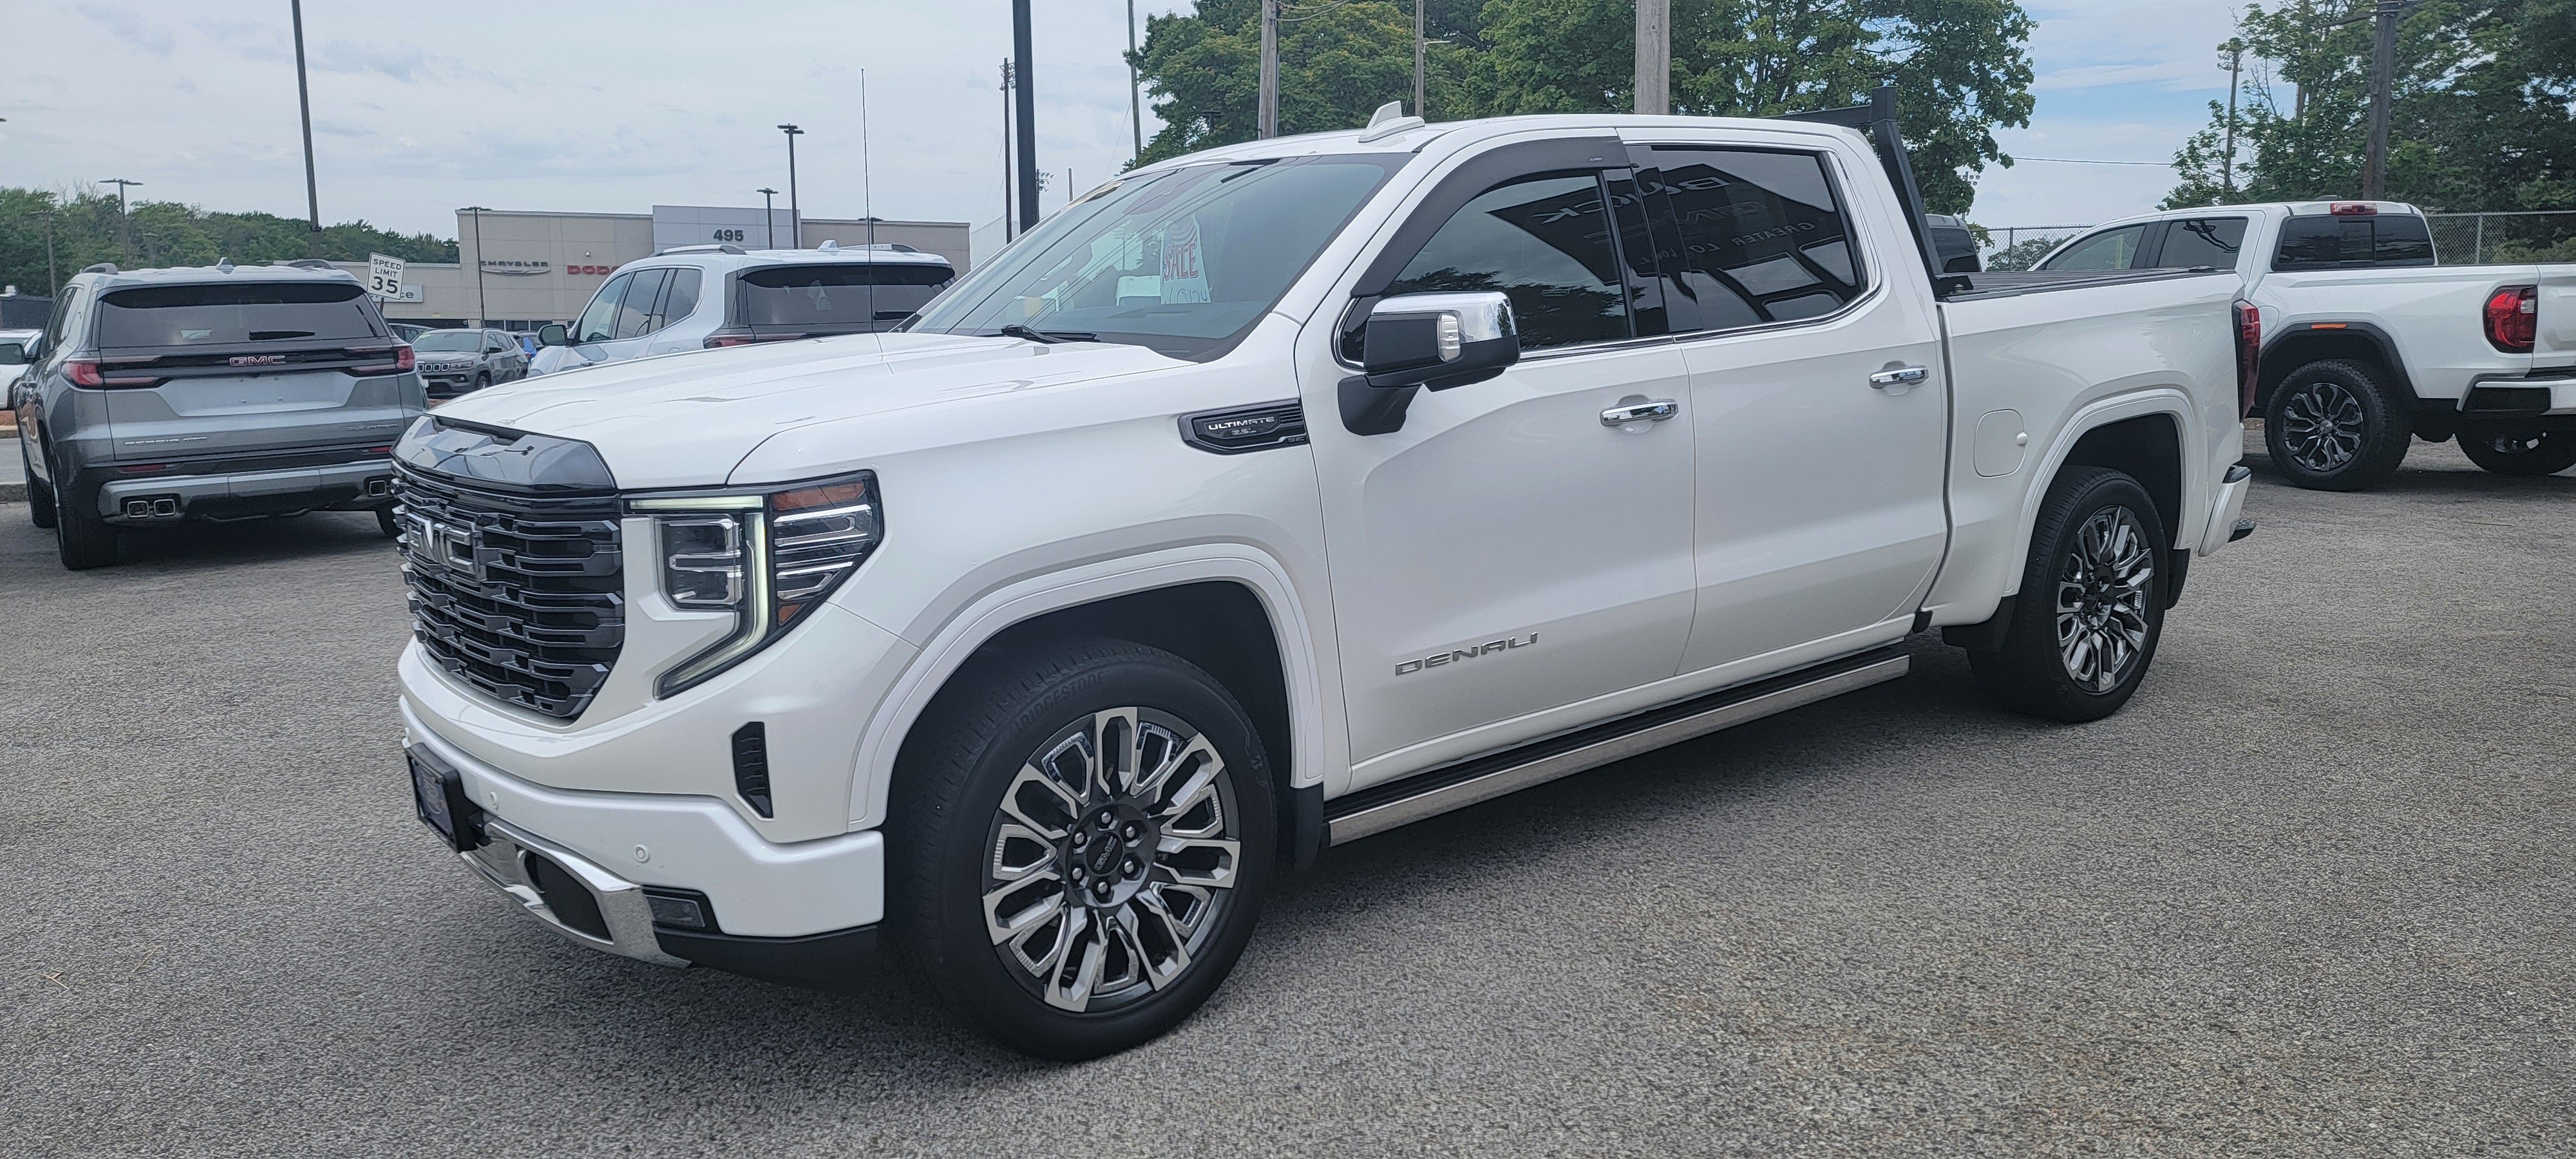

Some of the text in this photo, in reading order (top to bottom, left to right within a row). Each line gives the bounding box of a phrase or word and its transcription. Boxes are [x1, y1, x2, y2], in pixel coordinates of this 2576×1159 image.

[713, 229, 744, 242] 495
[373, 258, 401, 270] SPEED
[1163, 243, 1199, 281] SALE
[375, 267, 397, 278] LIMIT
[371, 276, 398, 294] 35
[229, 355, 286, 367] GMC
[1208, 417, 1275, 430] ULTIMATE
[1395, 631, 1539, 677] DENALI
[1094, 836, 1117, 871] GMC
